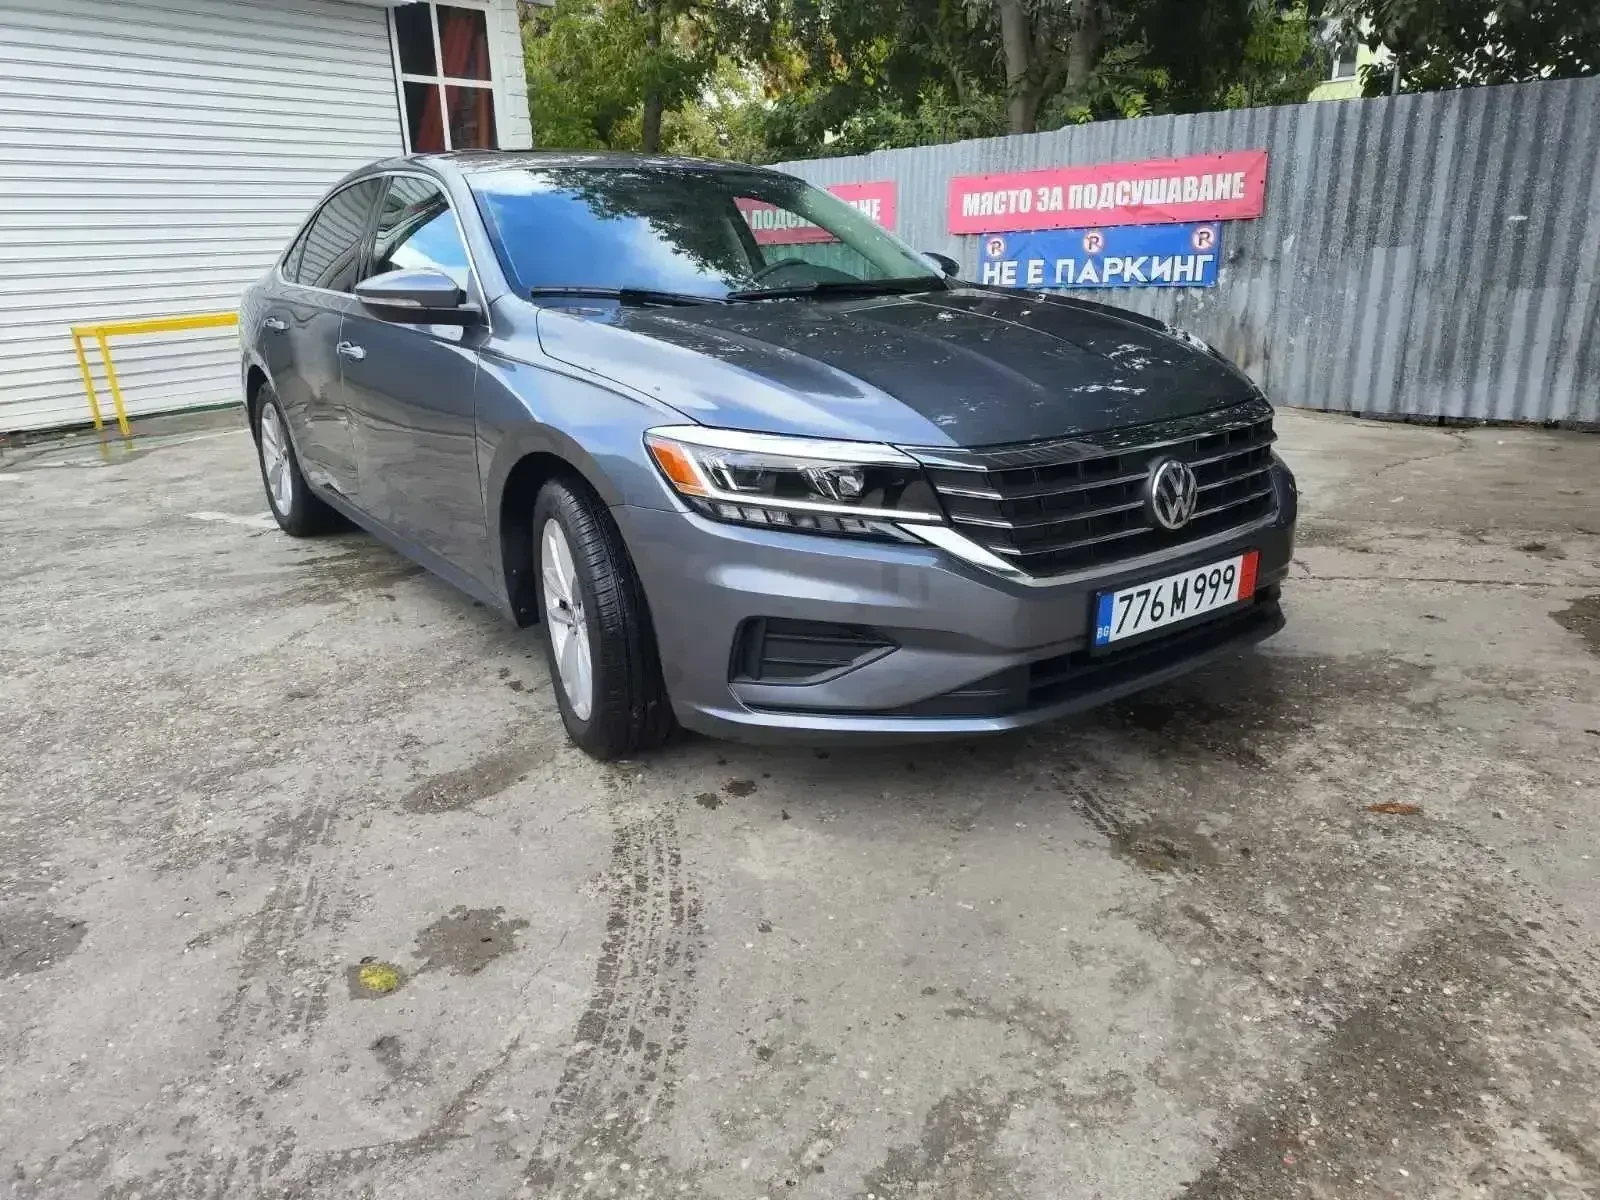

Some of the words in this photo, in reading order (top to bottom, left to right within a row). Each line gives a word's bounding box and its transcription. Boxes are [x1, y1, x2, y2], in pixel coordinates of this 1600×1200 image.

[962, 188, 1032, 217] МЯСТО
[1036, 187, 1063, 212] ЗА
[1068, 171, 1246, 210] ПОДСУШАВАНЕ
[982, 260, 1018, 285] НЕ
[1027, 259, 1045, 284] Е
[1055, 254, 1214, 283] ПАРКИНГ
